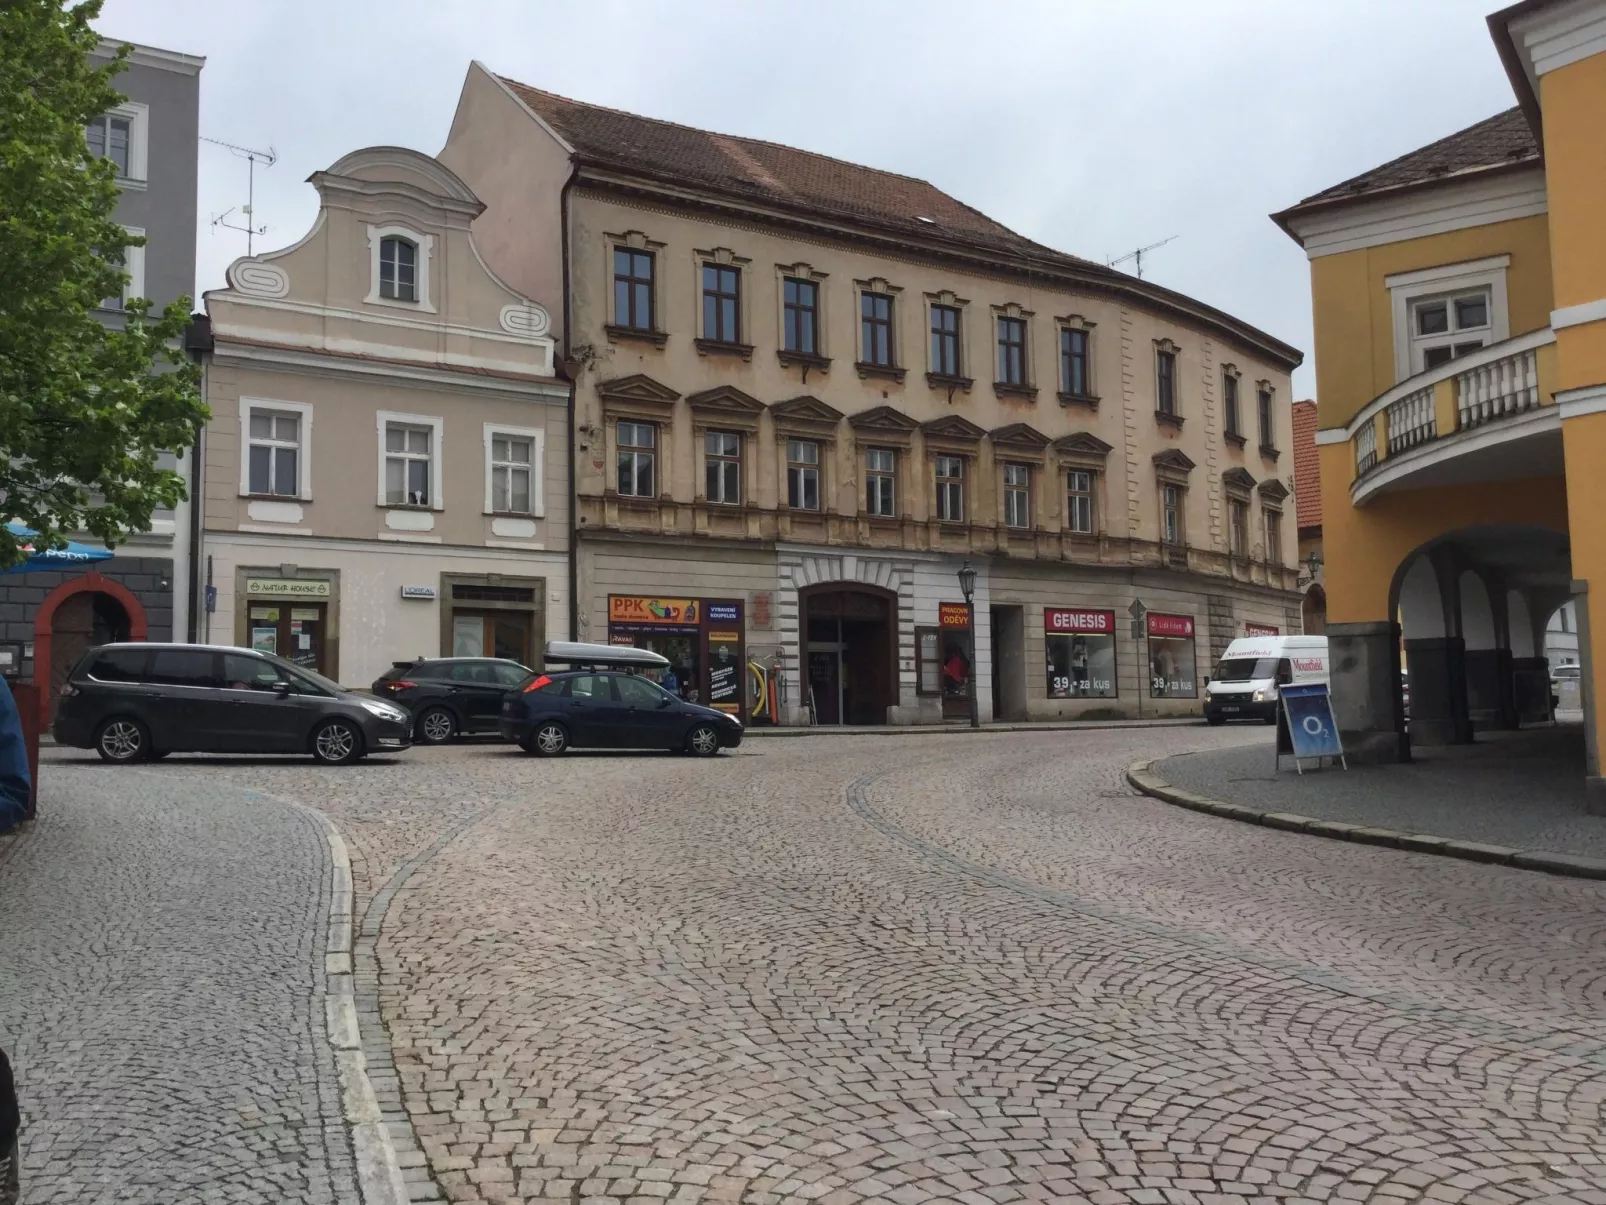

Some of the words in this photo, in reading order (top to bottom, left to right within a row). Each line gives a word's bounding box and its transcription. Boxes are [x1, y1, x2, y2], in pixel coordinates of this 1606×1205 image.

[614, 599, 644, 612] PPK
[941, 606, 969, 614] PRACOVN
[943, 614, 969, 624] ODĚVY
[1053, 613, 1106, 629] GENESIS
[1227, 650, 1272, 658] Mountfield
[1292, 658, 1323, 671] Mountfield
[1079, 682, 1091, 690] za
[1093, 678, 1110, 690] kus
[1171, 681, 1179, 690] za
[1180, 679, 1193, 690] kus
[1303, 716, 1330, 738] O2
